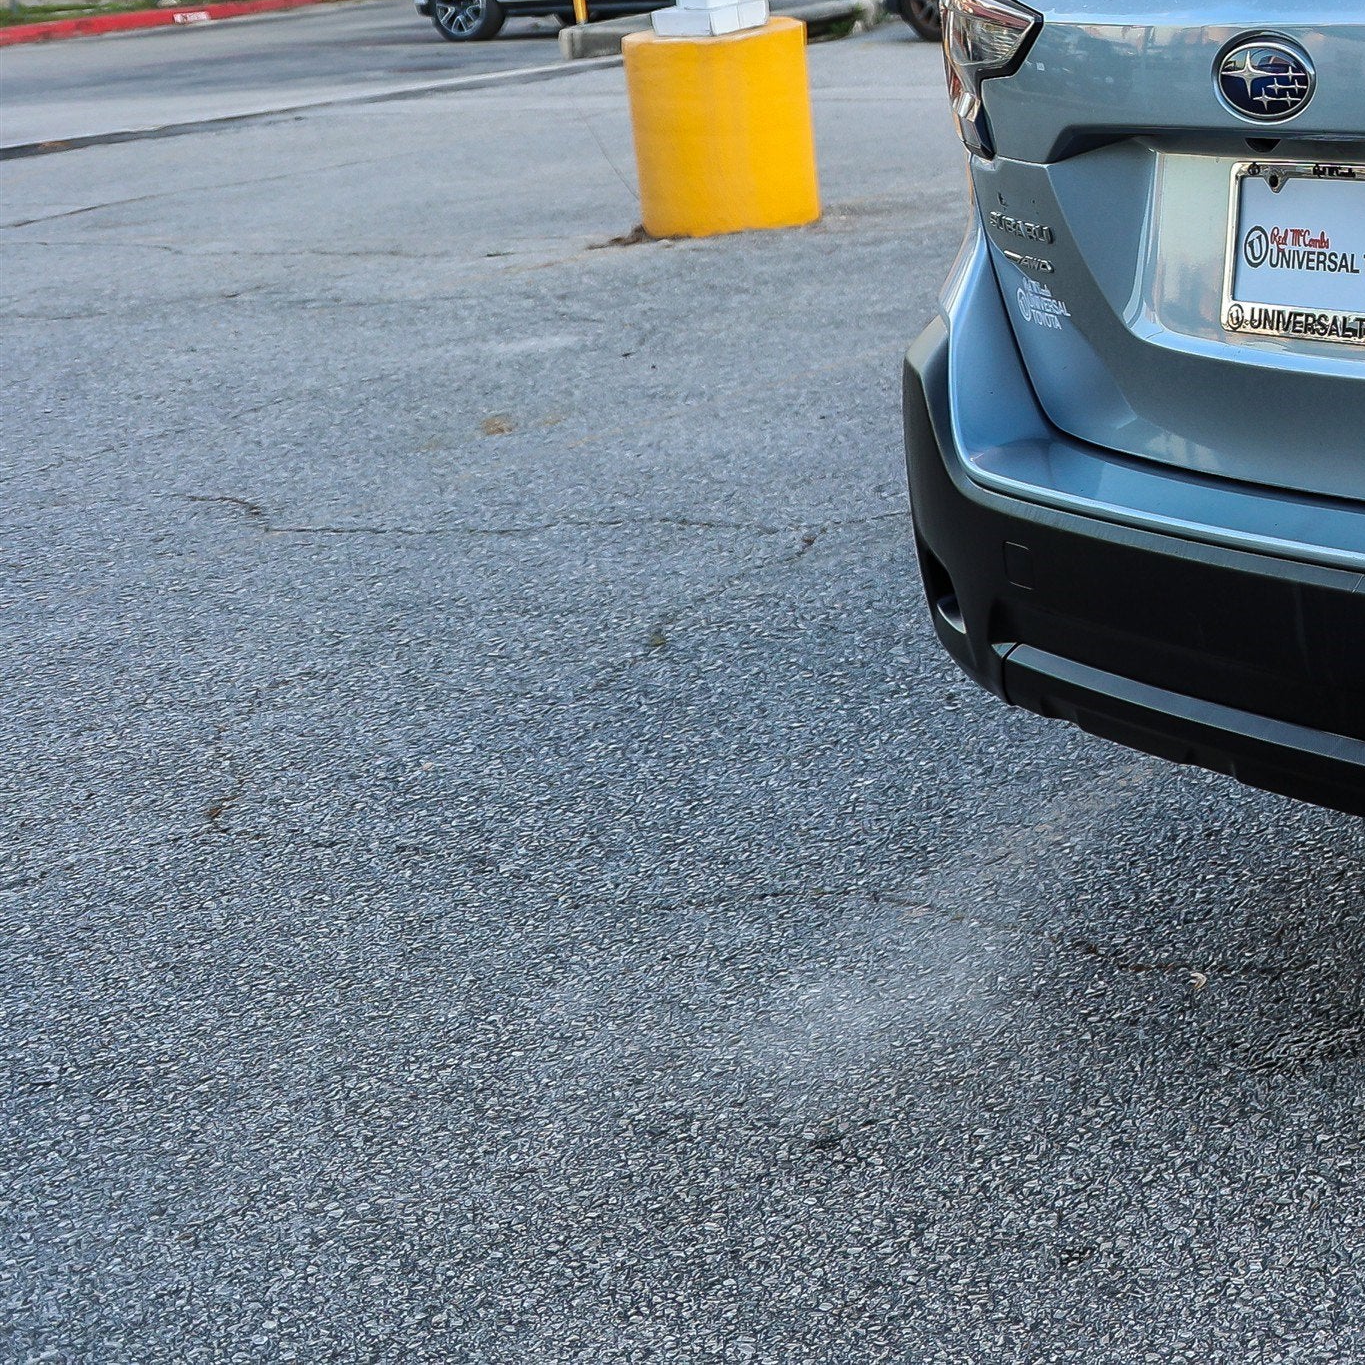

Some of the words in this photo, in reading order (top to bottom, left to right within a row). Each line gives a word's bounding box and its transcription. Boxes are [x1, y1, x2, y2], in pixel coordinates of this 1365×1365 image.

[989, 211, 1054, 243] SUBARU
[1270, 226, 1289, 252] Red
[1290, 228, 1331, 250] McCombs
[1269, 249, 1360, 274] UNIVERSAL
[1250, 307, 1351, 338] UNIVERSAL
